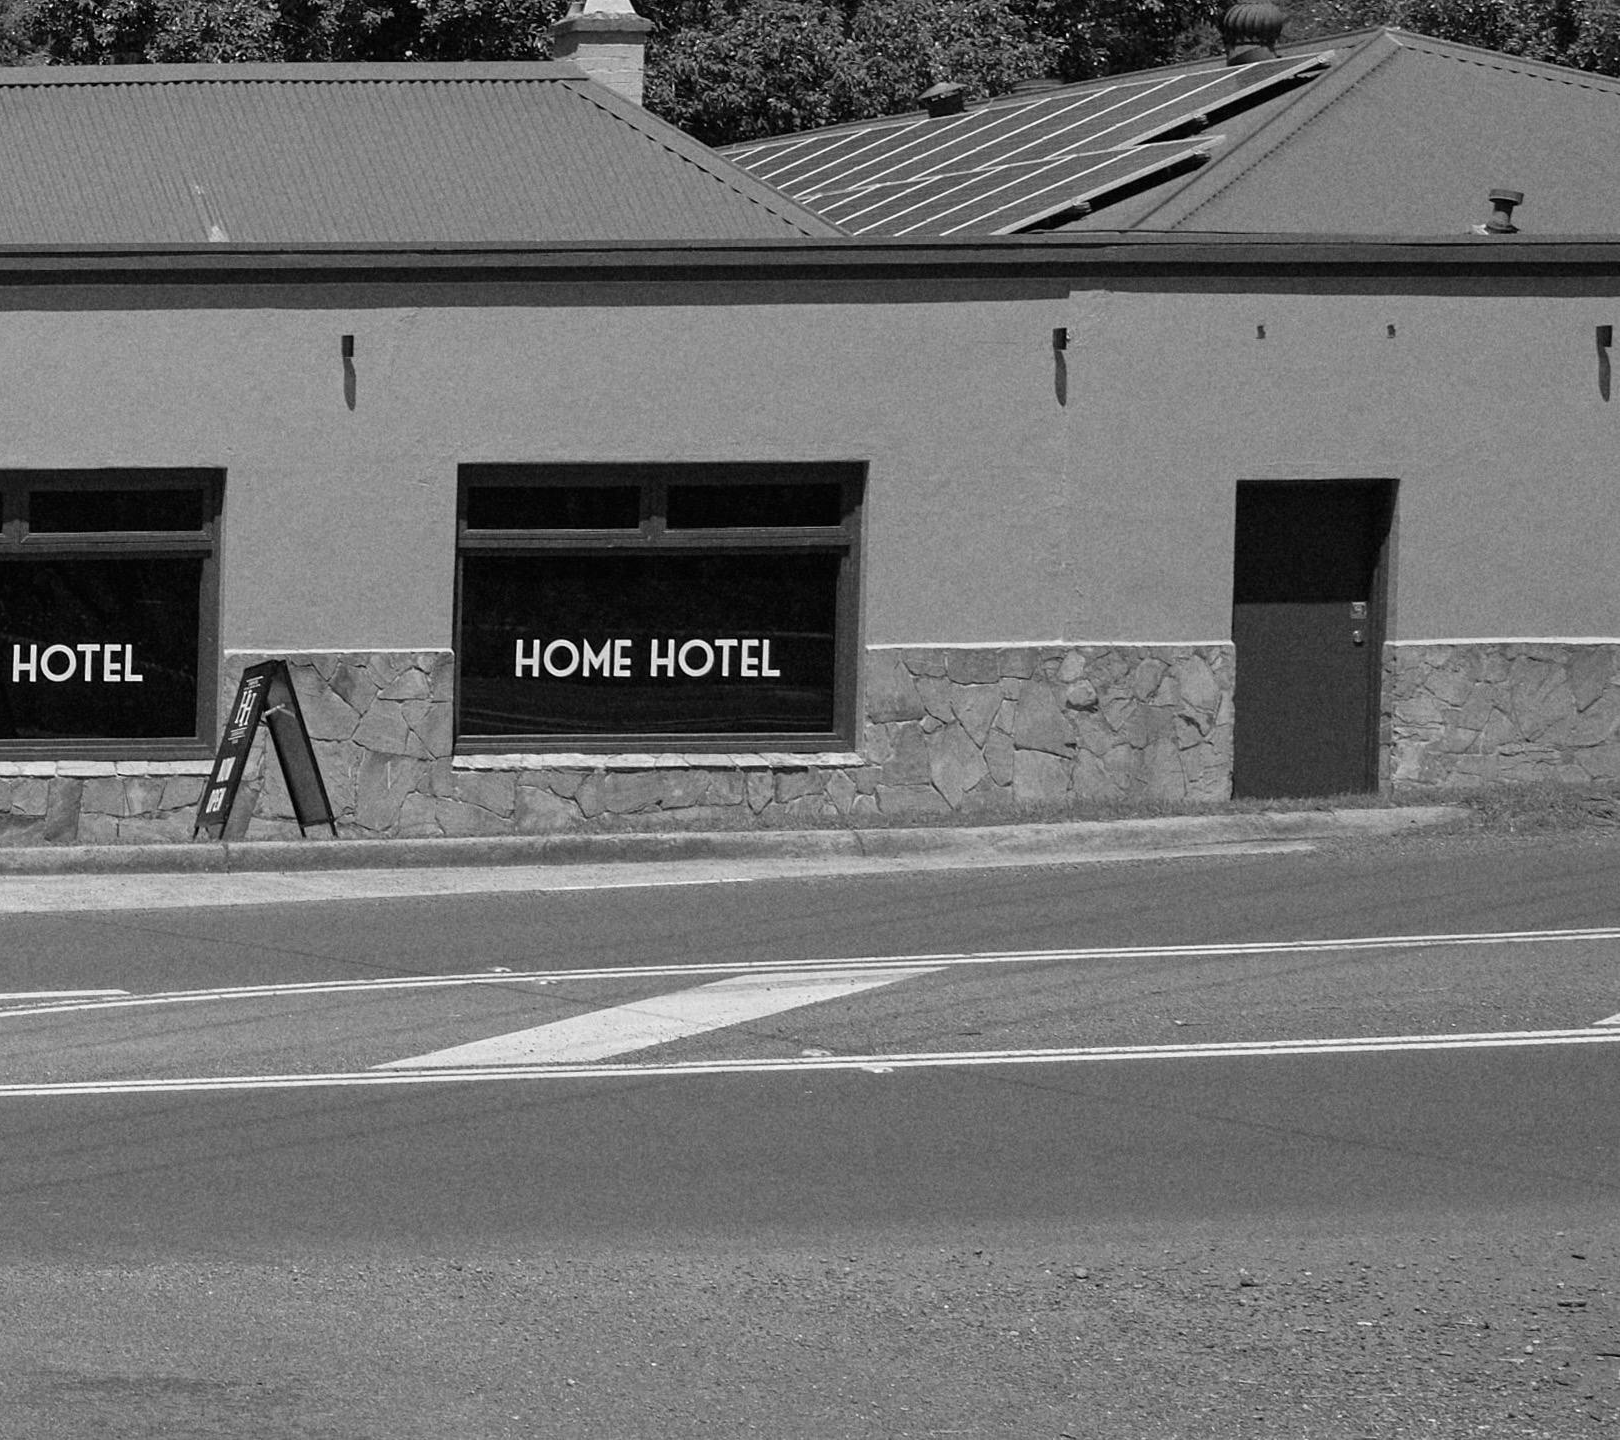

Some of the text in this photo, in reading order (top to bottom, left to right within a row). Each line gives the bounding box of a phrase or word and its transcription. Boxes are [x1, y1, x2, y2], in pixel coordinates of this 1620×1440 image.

[12, 643, 143, 683] HOTEL
[515, 638, 781, 678] HOME HOTEL
